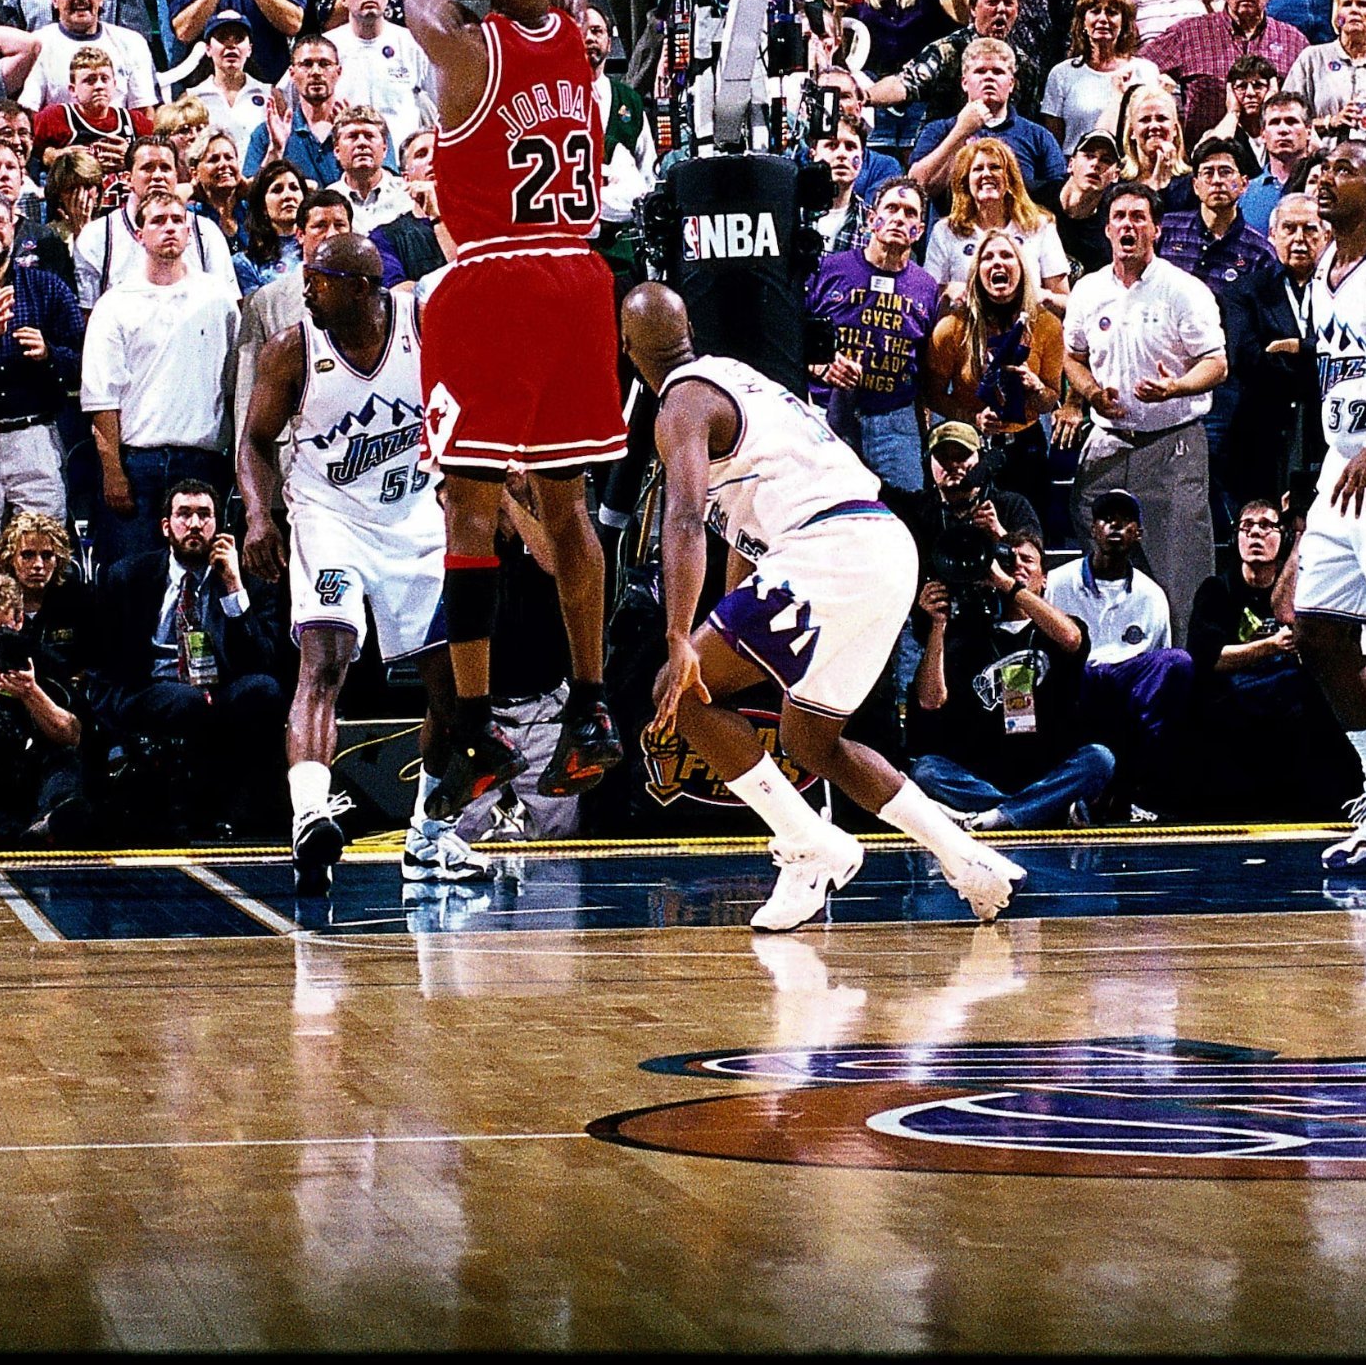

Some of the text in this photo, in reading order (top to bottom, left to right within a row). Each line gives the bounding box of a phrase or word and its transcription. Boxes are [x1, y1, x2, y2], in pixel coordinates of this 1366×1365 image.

[497, 80, 592, 142] JORDA
[507, 130, 601, 226] 23
[700, 212, 781, 260] NBA
[850, 288, 867, 305] IT
[861, 308, 903, 332] OVER
[838, 327, 913, 356] TILL THE
[839, 347, 908, 374] AT LADY
[853, 372, 895, 393] INGS
[380, 465, 431, 506] 55
